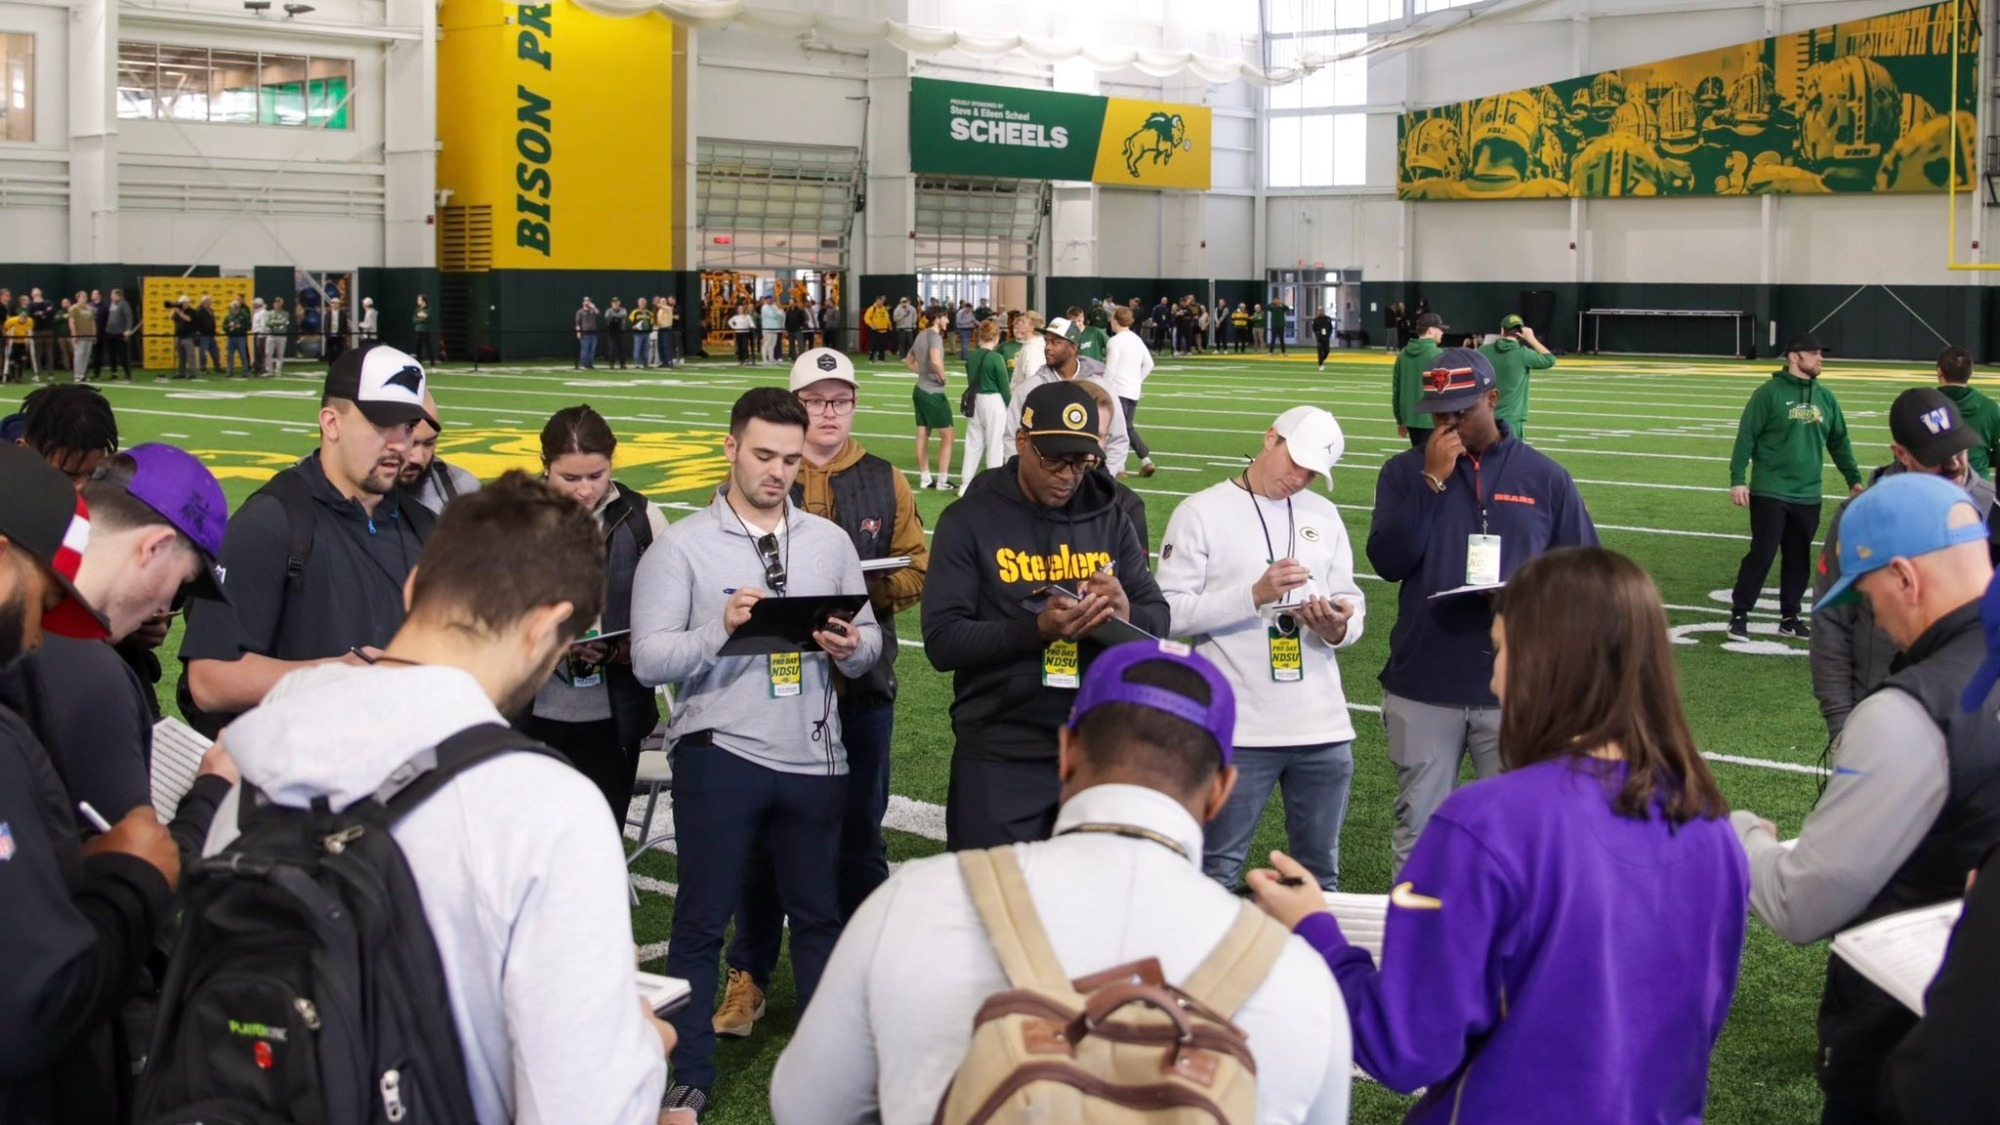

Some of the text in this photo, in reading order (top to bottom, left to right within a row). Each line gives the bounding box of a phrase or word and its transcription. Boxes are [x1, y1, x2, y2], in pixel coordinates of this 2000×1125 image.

[950, 105, 1030, 121] Steve & Eileen Scheel
[950, 117, 1069, 149] SCHEELS
[516, 84, 552, 258] BISON
[1920, 406, 1950, 435] W
[996, 544, 1113, 583] Steelers
[772, 657, 798, 666] PRO DAY
[1045, 656, 1077, 668] NDSU
[1272, 652, 1300, 662] NDSU
[772, 665, 800, 676] NDSU
